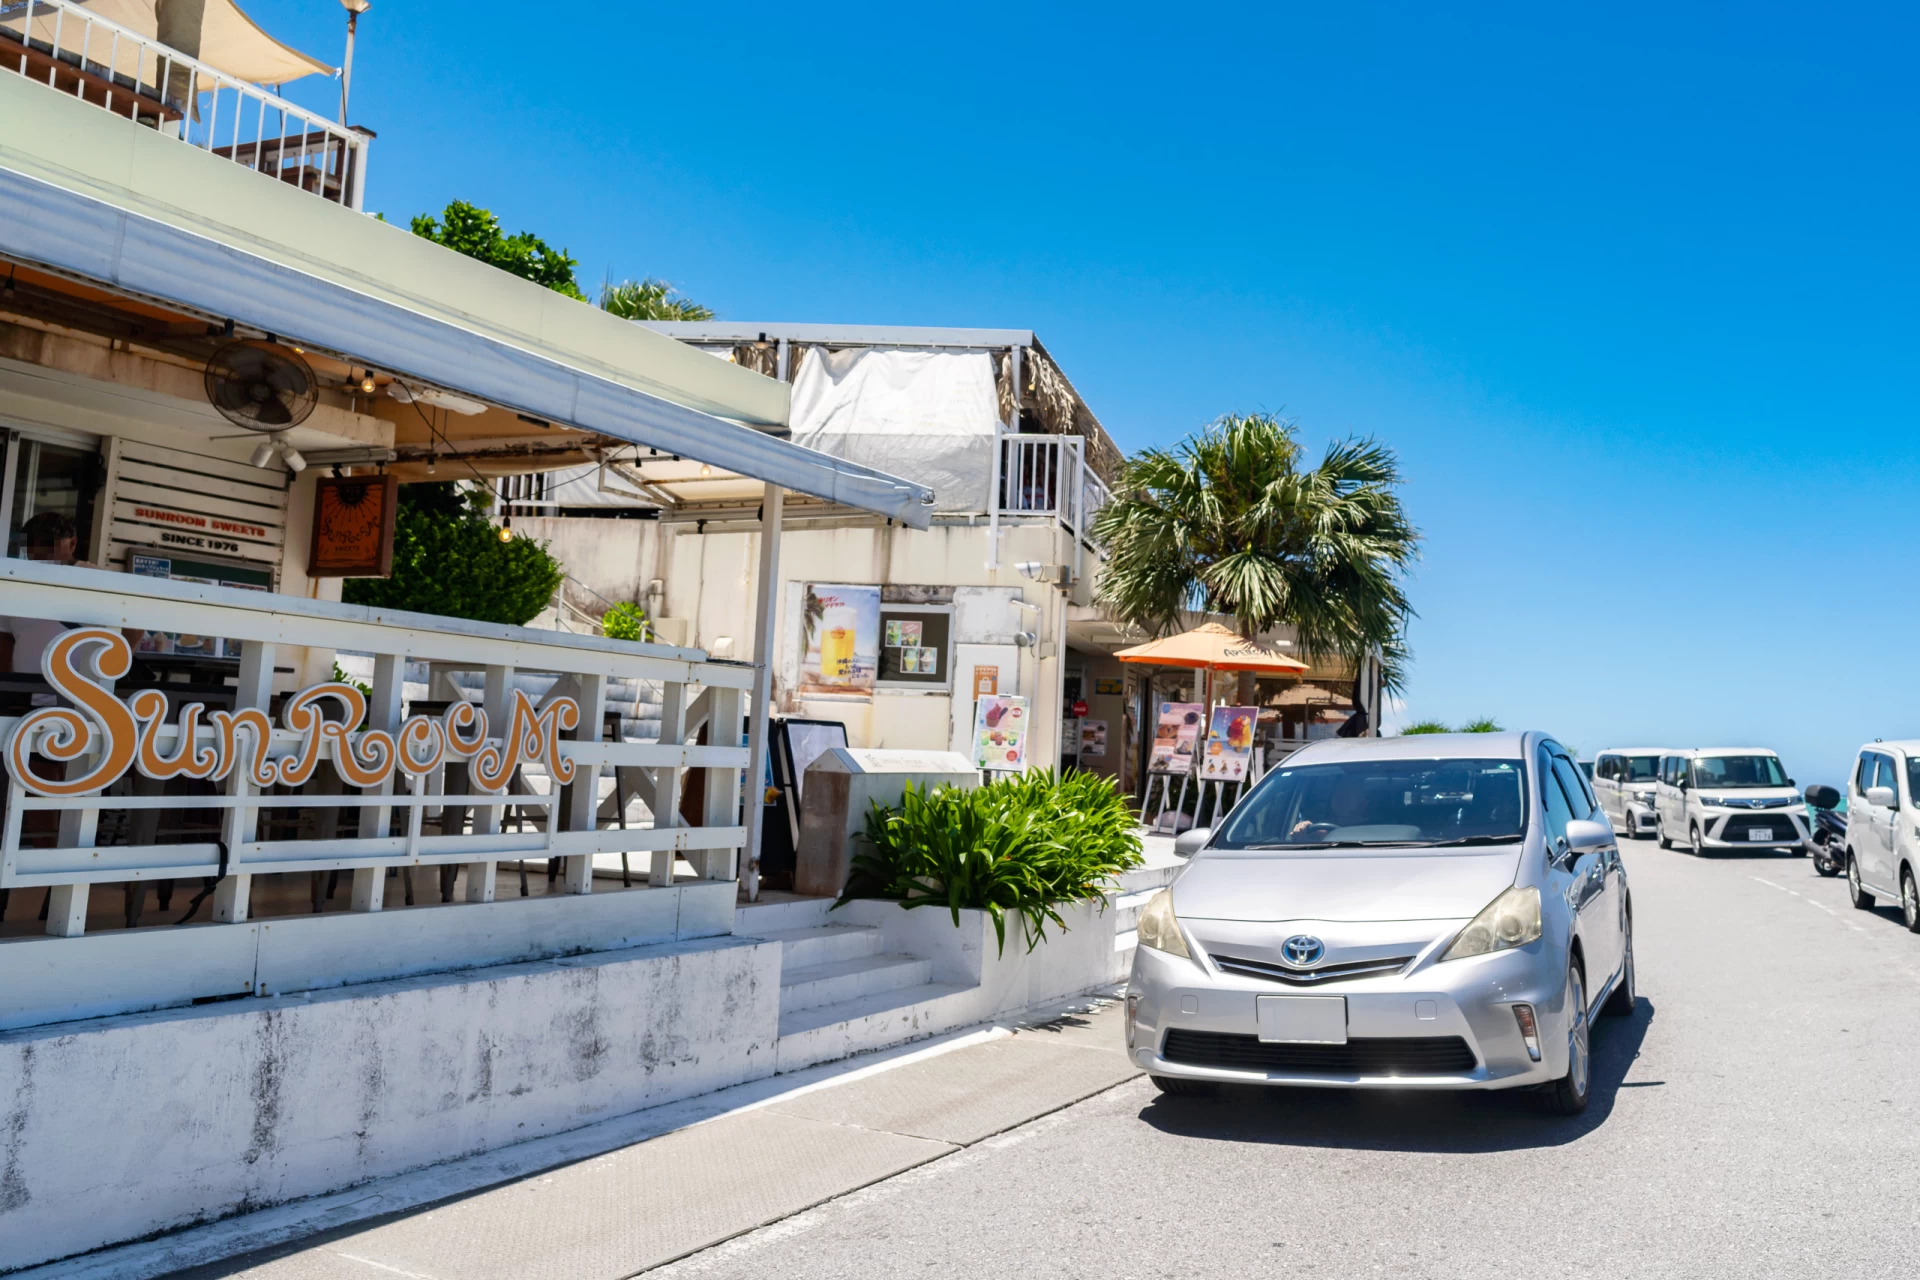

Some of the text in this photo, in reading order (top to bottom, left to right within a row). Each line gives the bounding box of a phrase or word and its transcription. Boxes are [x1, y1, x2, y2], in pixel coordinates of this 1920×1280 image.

[134, 507, 266, 537] SUNROOM SWEETS
[161, 533, 239, 552] SINCE 1976
